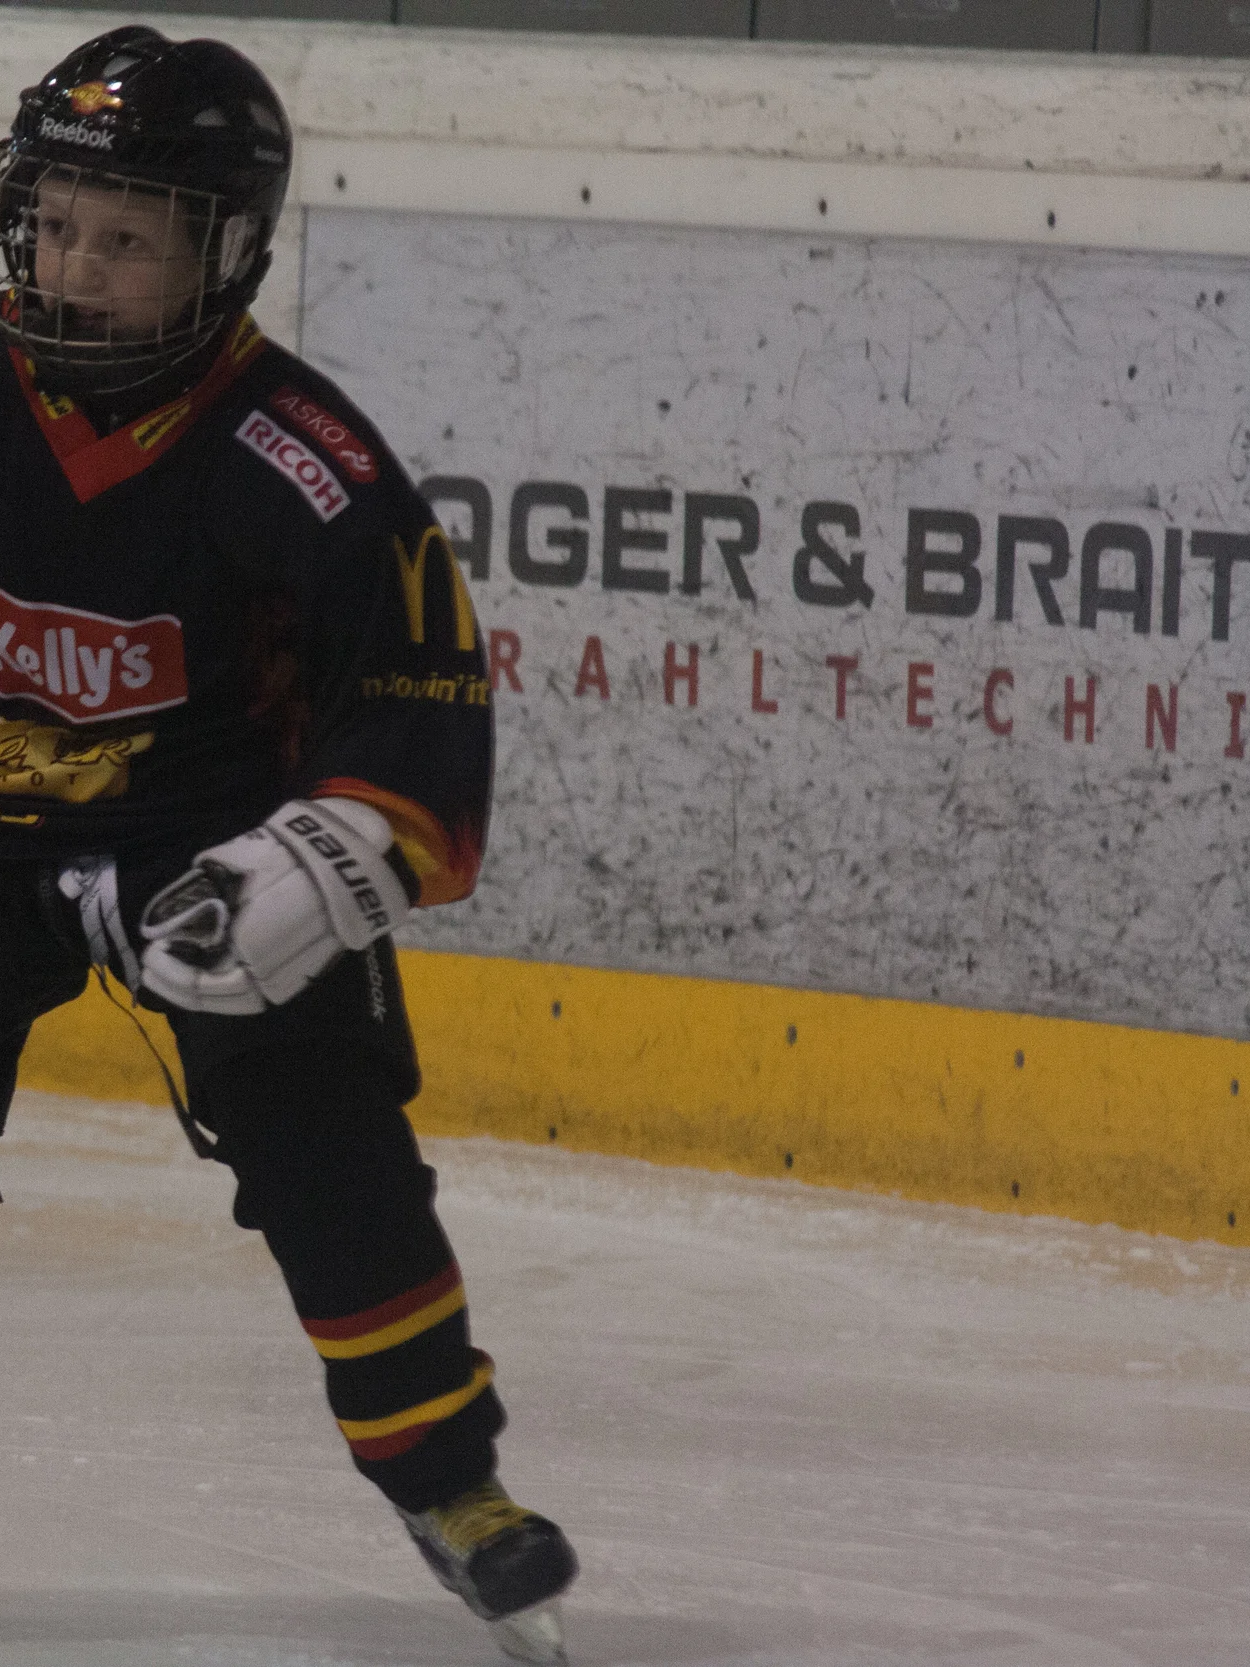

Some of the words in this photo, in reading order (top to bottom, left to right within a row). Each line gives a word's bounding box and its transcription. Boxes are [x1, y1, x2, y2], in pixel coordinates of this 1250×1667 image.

[39, 116, 116, 151] Reebok
[244, 418, 343, 513] RICOH
[792, 499, 875, 610] &
[904, 506, 1250, 642] BRAIT
[284, 814, 391, 933] BAUER
